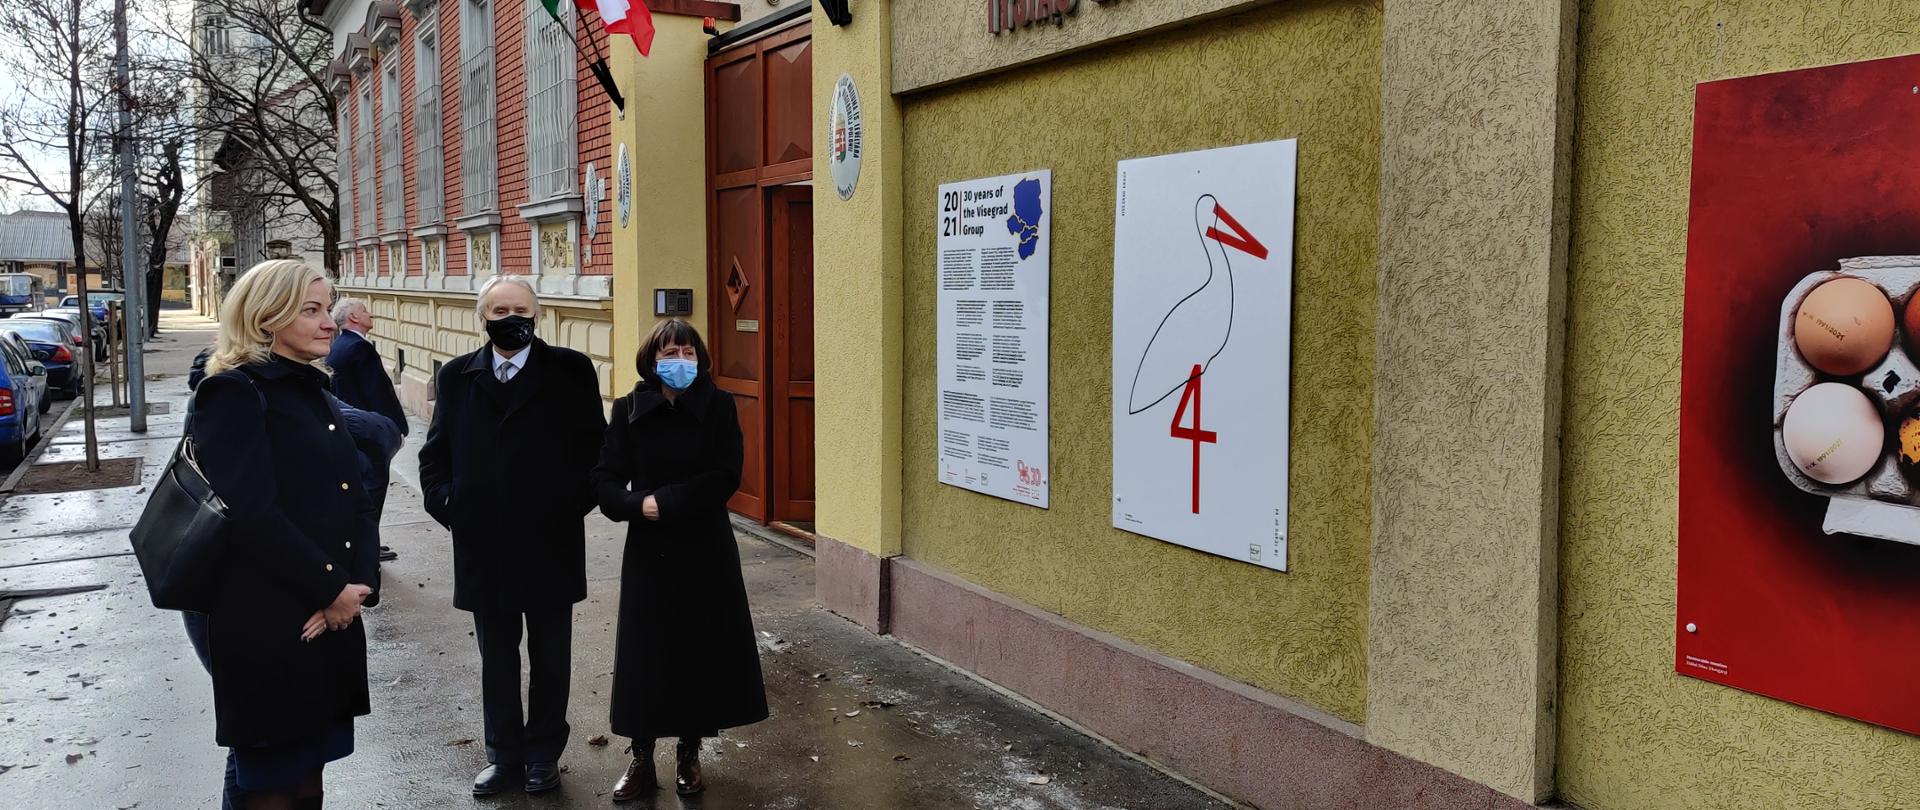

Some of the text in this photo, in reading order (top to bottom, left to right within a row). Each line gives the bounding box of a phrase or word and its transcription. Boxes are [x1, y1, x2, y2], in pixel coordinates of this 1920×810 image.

[944, 190, 959, 213] 20
[963, 184, 1004, 203] 30 years of
[963, 202, 1009, 220] the Visegrad
[943, 216, 957, 237] 21
[963, 223, 984, 238] Group
